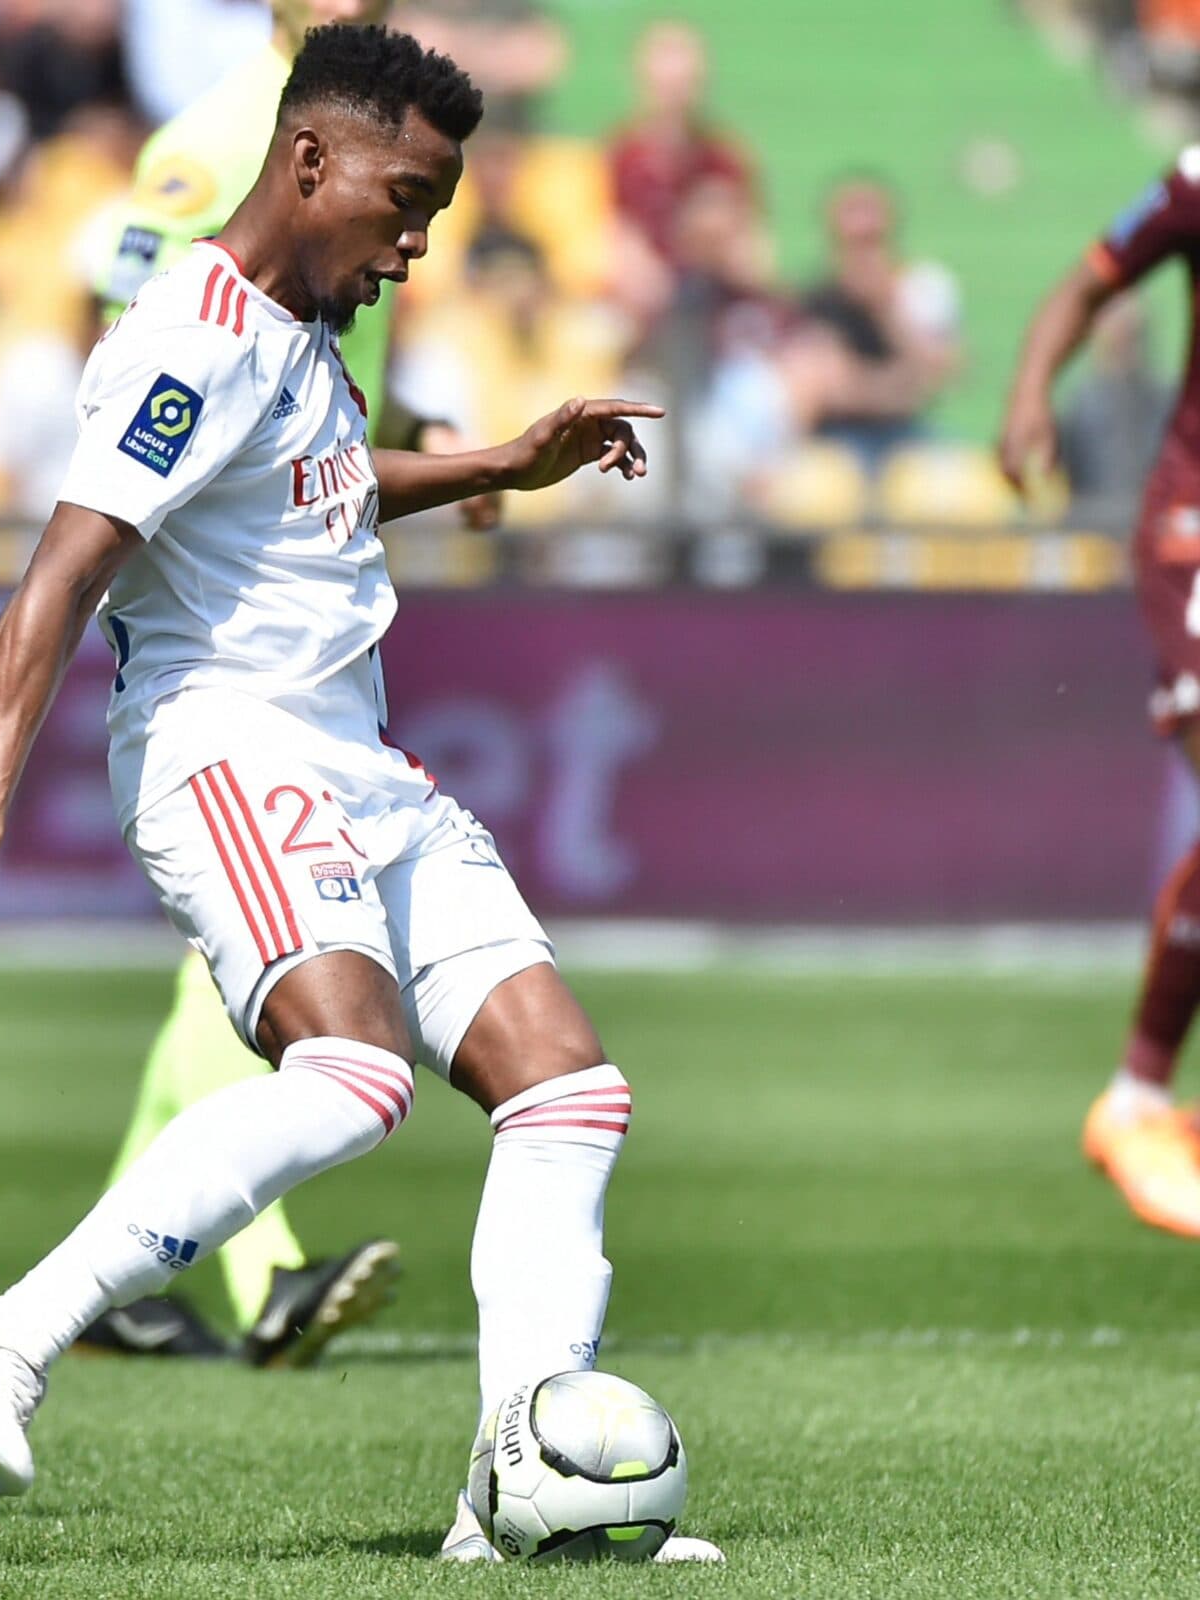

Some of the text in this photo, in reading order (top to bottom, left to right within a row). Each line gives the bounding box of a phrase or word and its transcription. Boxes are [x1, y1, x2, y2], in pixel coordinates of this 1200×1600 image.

[124, 436, 169, 469] Uber Eats
[134, 427, 174, 456] LIGUE 1
[127, 1223, 188, 1271] adida
